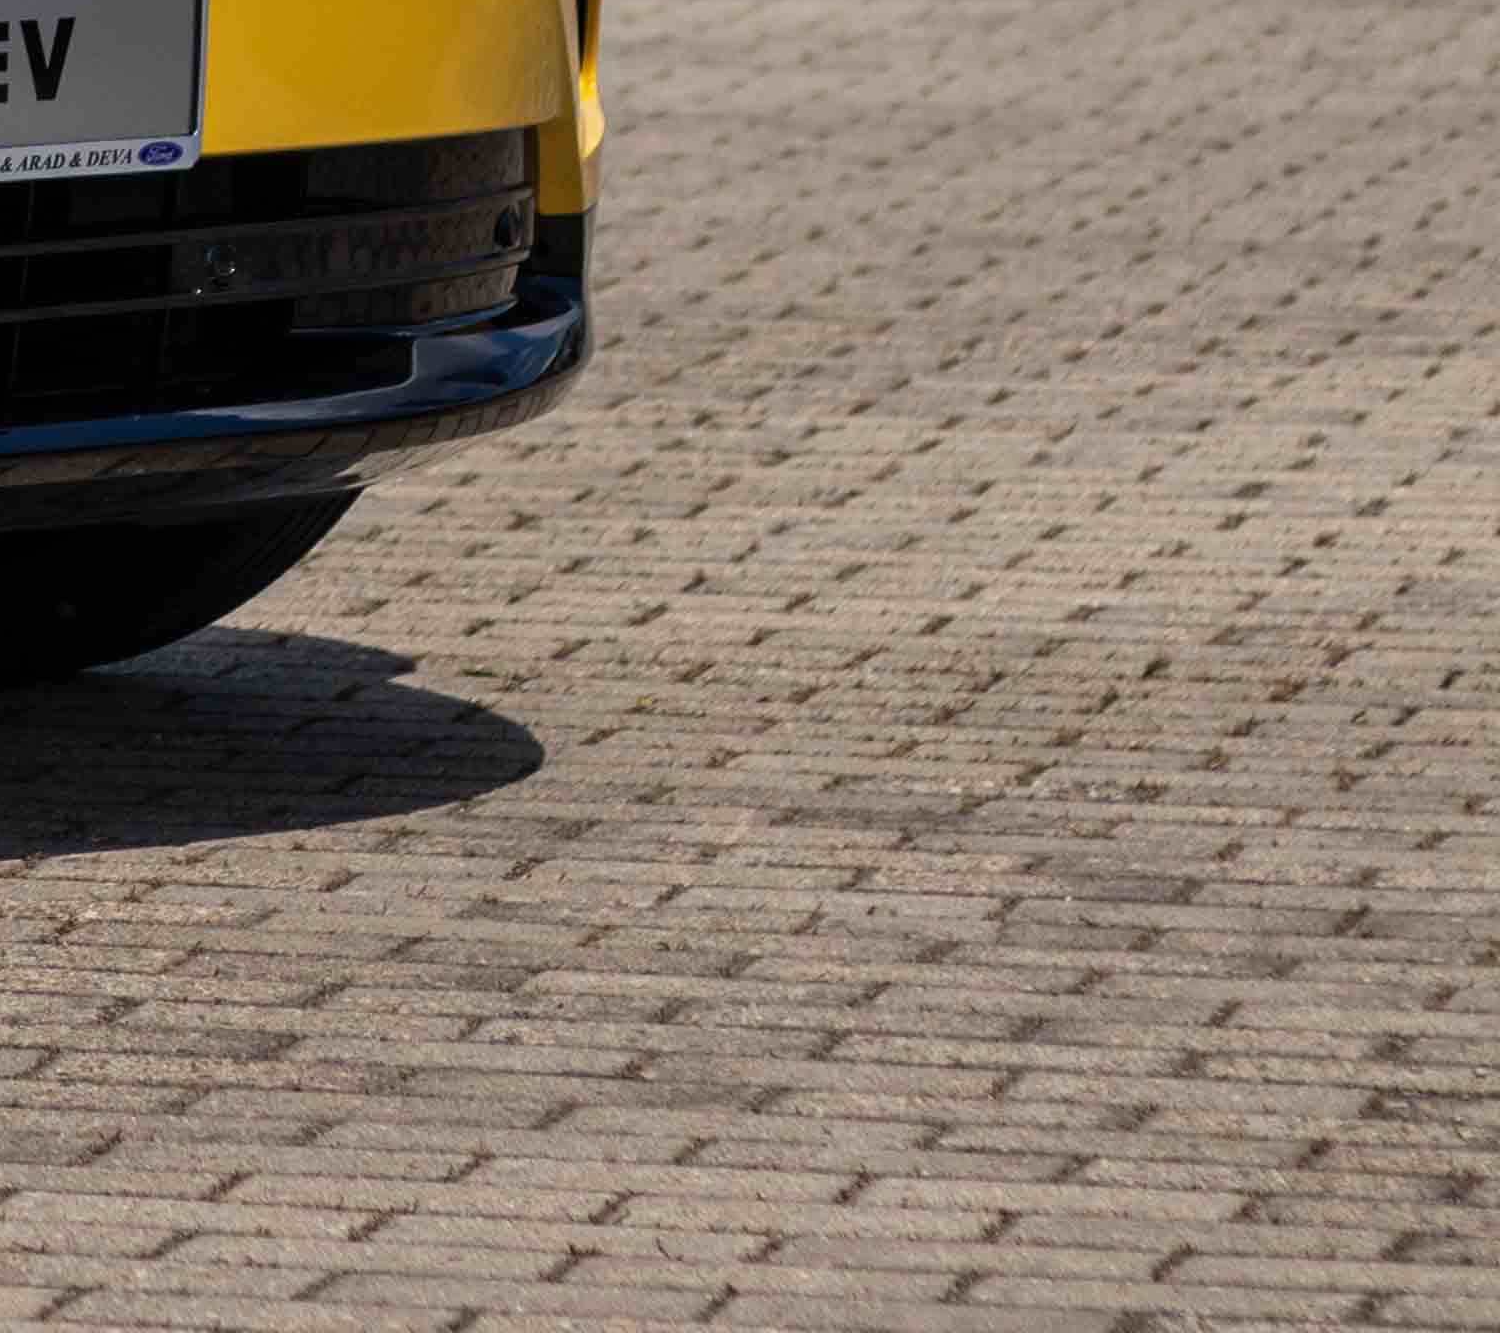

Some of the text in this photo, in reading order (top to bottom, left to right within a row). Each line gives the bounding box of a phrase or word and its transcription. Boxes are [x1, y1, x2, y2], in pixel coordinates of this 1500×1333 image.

[0, 156, 13, 173] &
[15, 151, 66, 171] ARAD
[68, 153, 83, 168] &
[86, 147, 133, 167] DEVA
